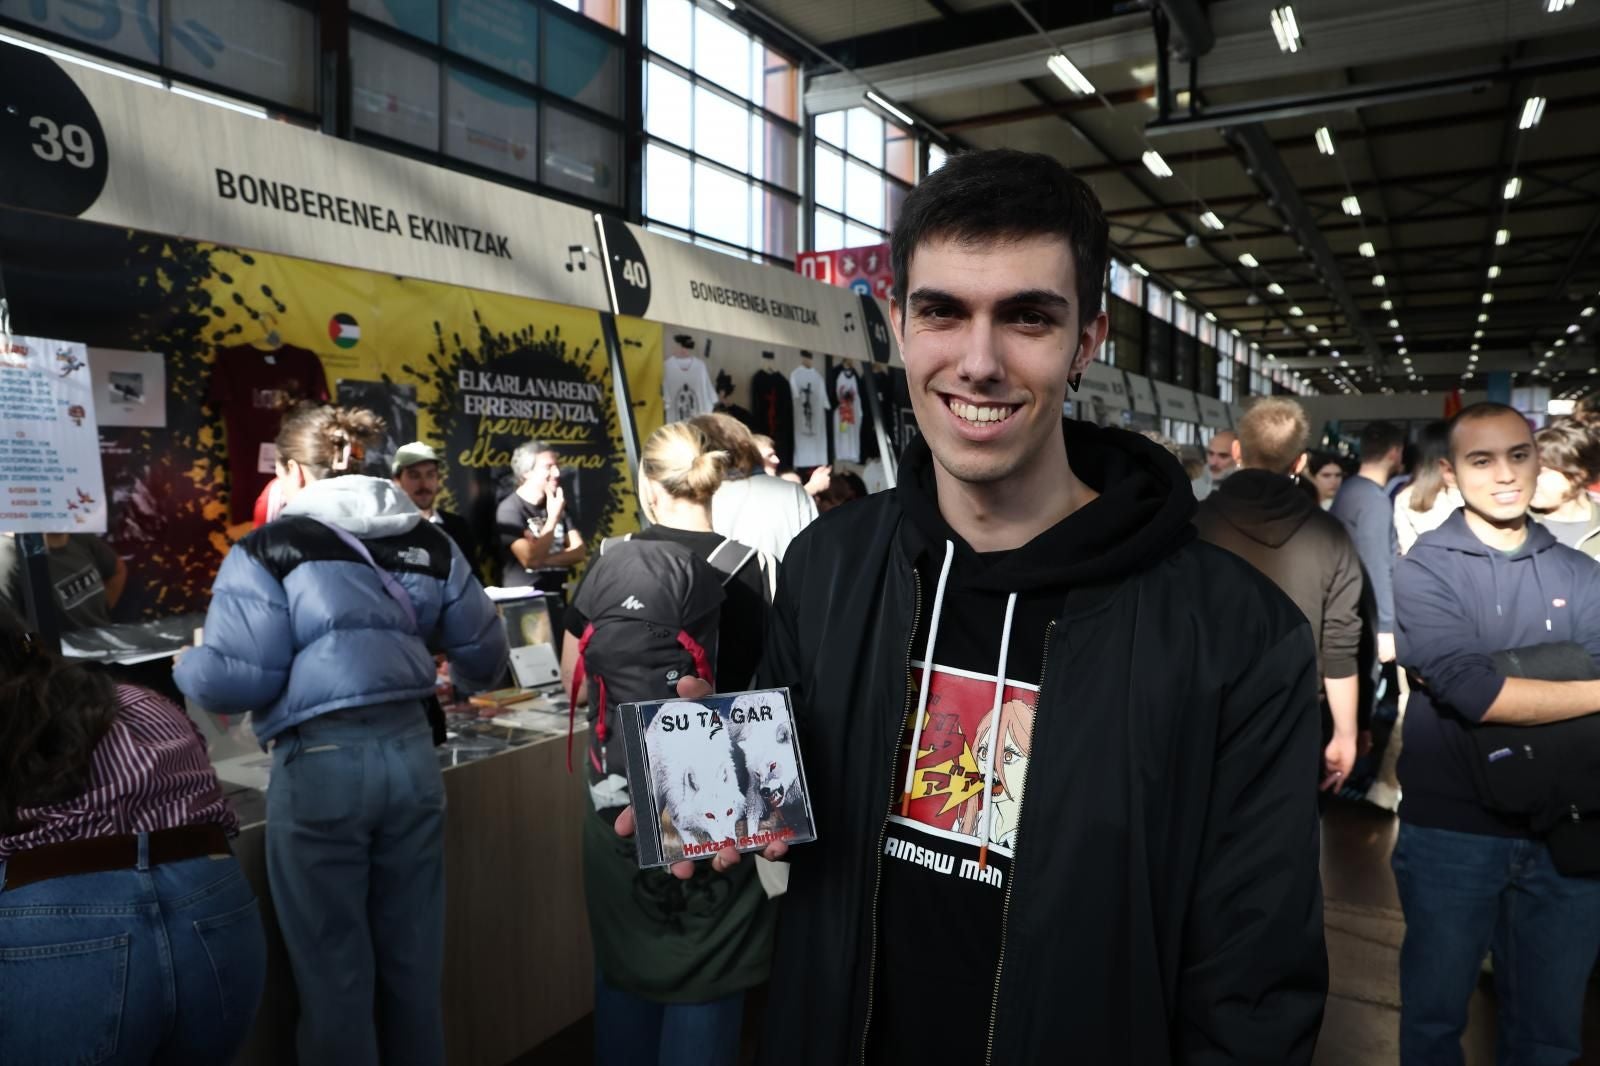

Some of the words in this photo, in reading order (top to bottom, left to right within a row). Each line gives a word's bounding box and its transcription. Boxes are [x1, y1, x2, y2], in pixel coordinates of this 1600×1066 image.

[29, 115, 95, 169] 39
[215, 168, 402, 236] BONBERENEA
[407, 213, 513, 260] EKINTZAK
[622, 258, 648, 289] 40
[690, 279, 769, 316] BONBERENEA
[769, 299, 820, 327] EKINTZAK
[458, 369, 603, 402] ELKARLANAREKIN
[661, 713, 690, 732] SU
[730, 705, 774, 725] GAR
